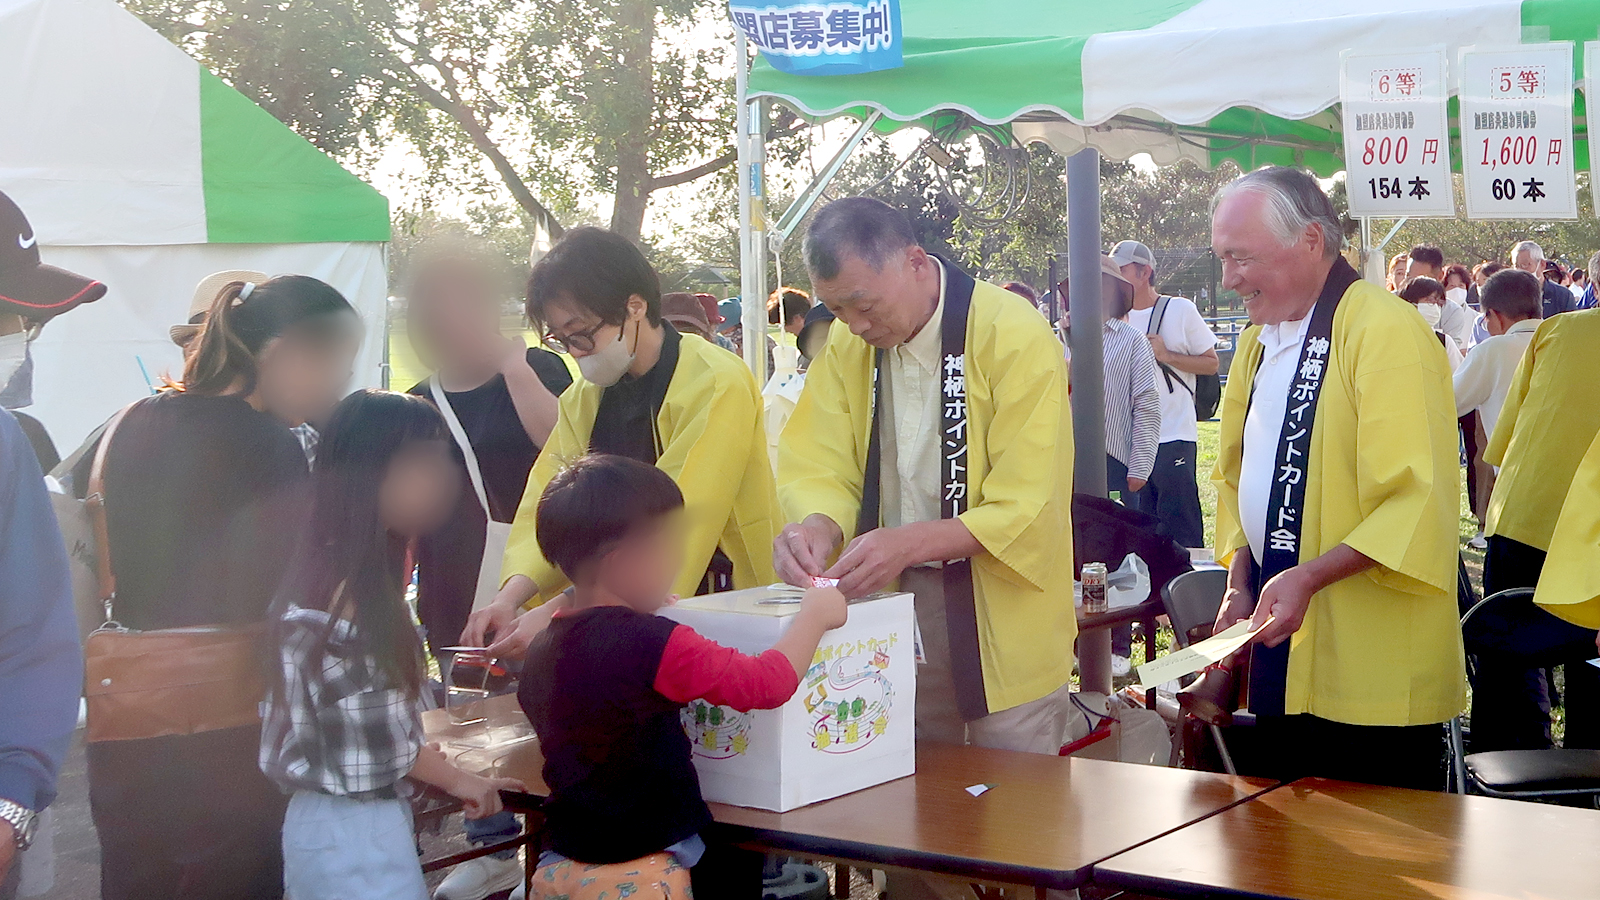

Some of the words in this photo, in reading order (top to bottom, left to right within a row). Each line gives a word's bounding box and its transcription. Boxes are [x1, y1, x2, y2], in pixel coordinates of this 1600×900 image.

[1270, 336, 1330, 553] 神栖ポイントカード会
